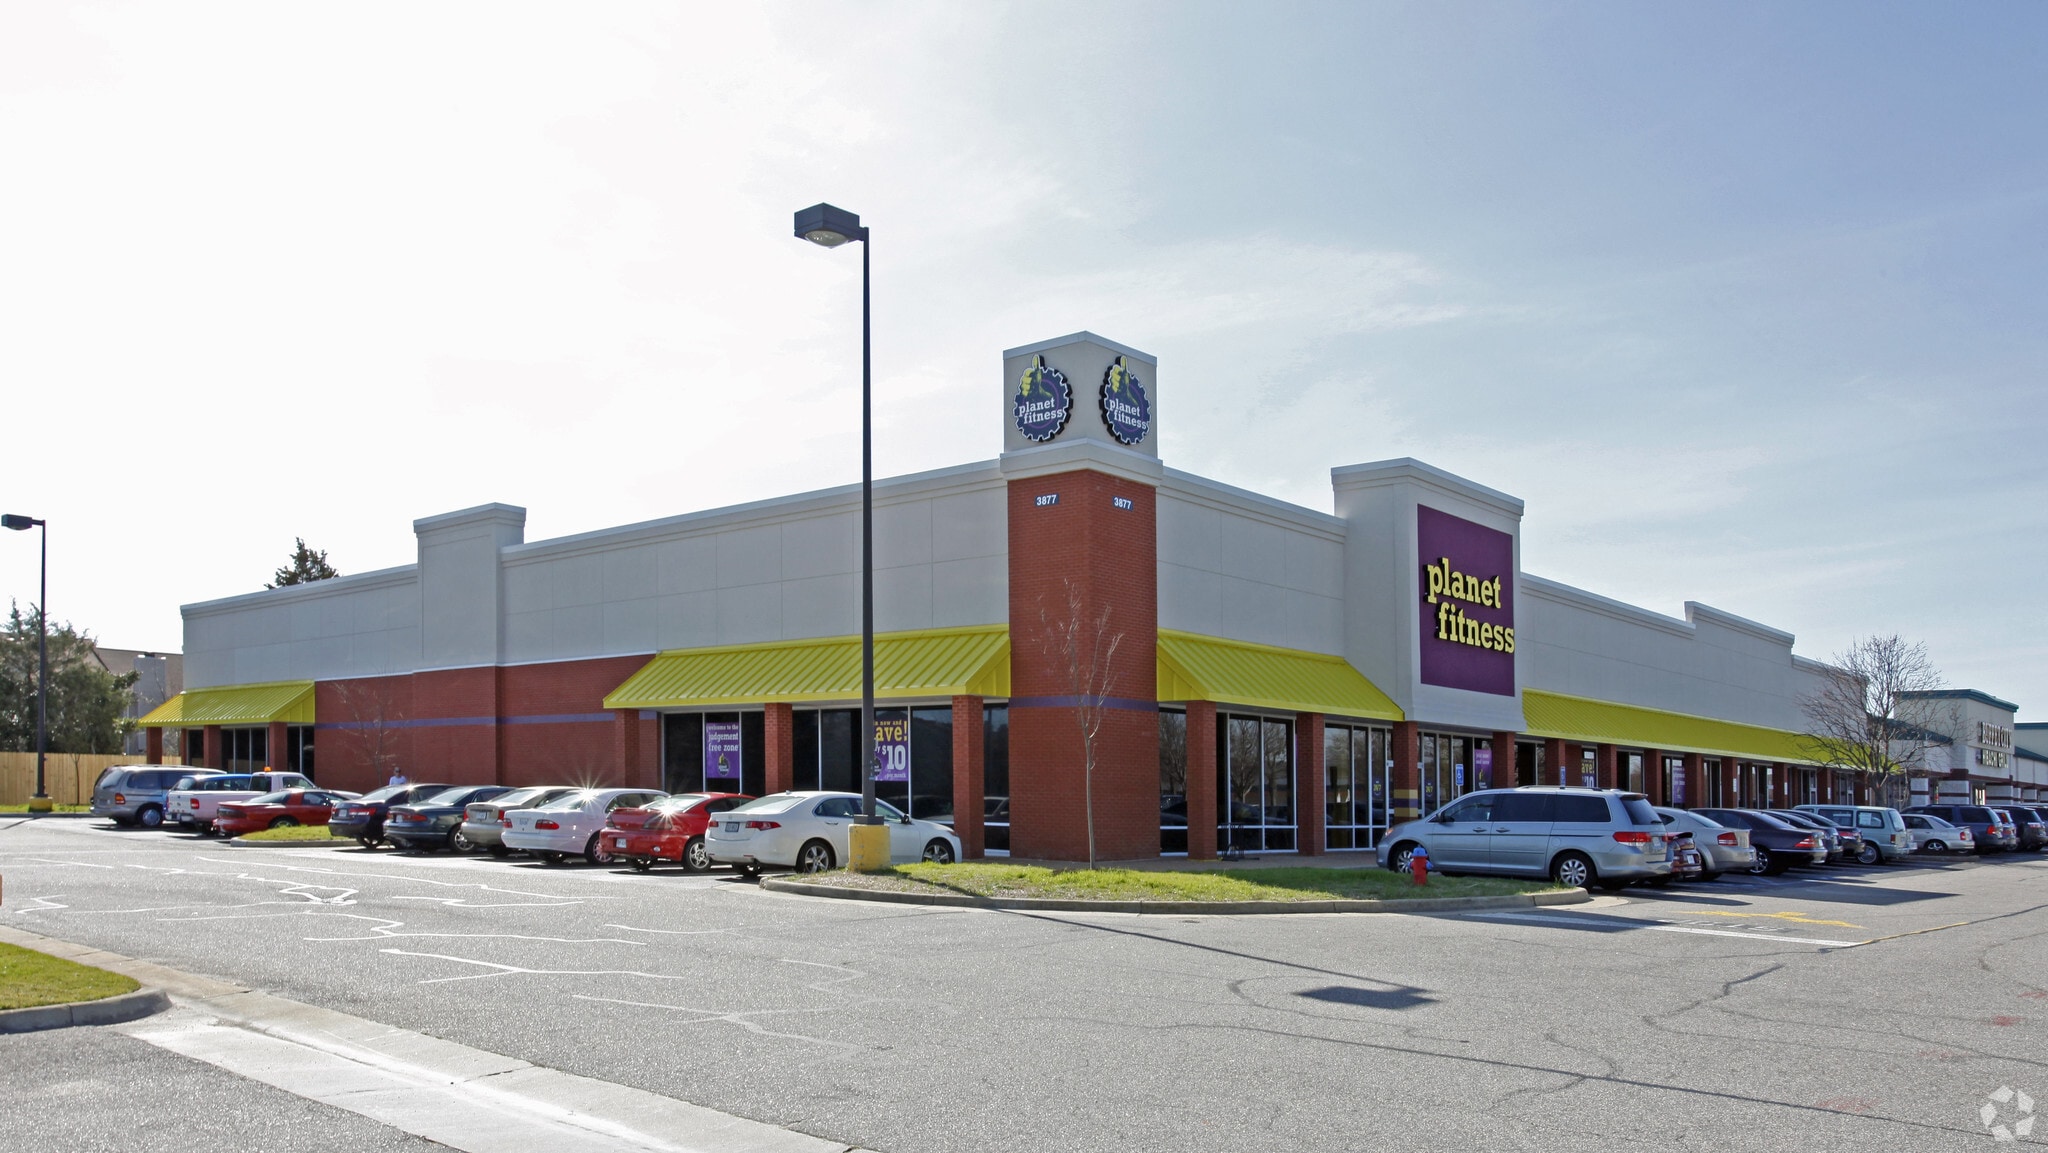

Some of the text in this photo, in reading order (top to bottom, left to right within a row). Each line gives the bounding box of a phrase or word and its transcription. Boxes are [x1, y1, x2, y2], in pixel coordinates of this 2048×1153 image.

[1018, 397, 1055, 417] planet
[1023, 408, 1063, 424] fitness
[1109, 398, 1141, 416] planet
[1113, 410, 1147, 430] fitness
[1036, 494, 1057, 506] 3877
[1114, 497, 1132, 509] 3877
[1427, 557, 1501, 609] planet
[1438, 601, 1515, 653] fitness
[708, 732, 738, 742] judgement
[875, 720, 907, 742] ave!
[708, 743, 738, 752] free zone
[881, 744, 906, 771] $10
